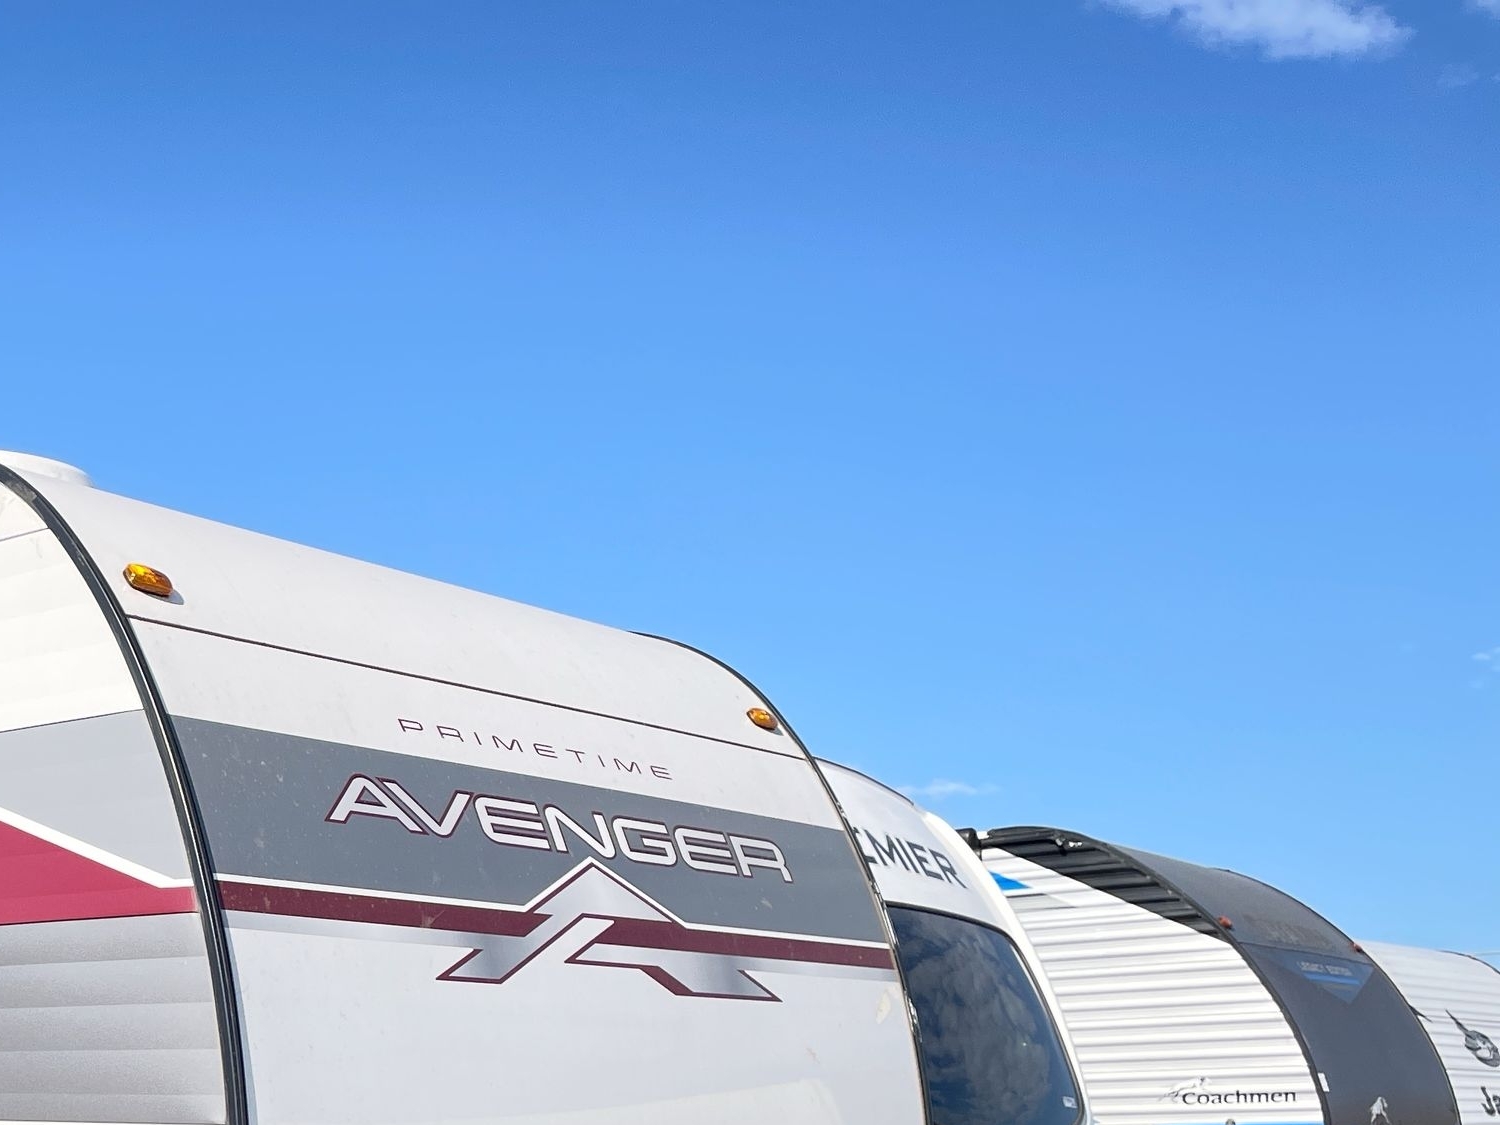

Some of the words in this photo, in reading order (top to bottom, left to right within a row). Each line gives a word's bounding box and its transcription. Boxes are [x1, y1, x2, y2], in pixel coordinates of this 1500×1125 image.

[397, 717, 673, 781] PRIMETIME
[324, 773, 794, 883] AVENGER
[1182, 1090, 1297, 1106] Coachmen
